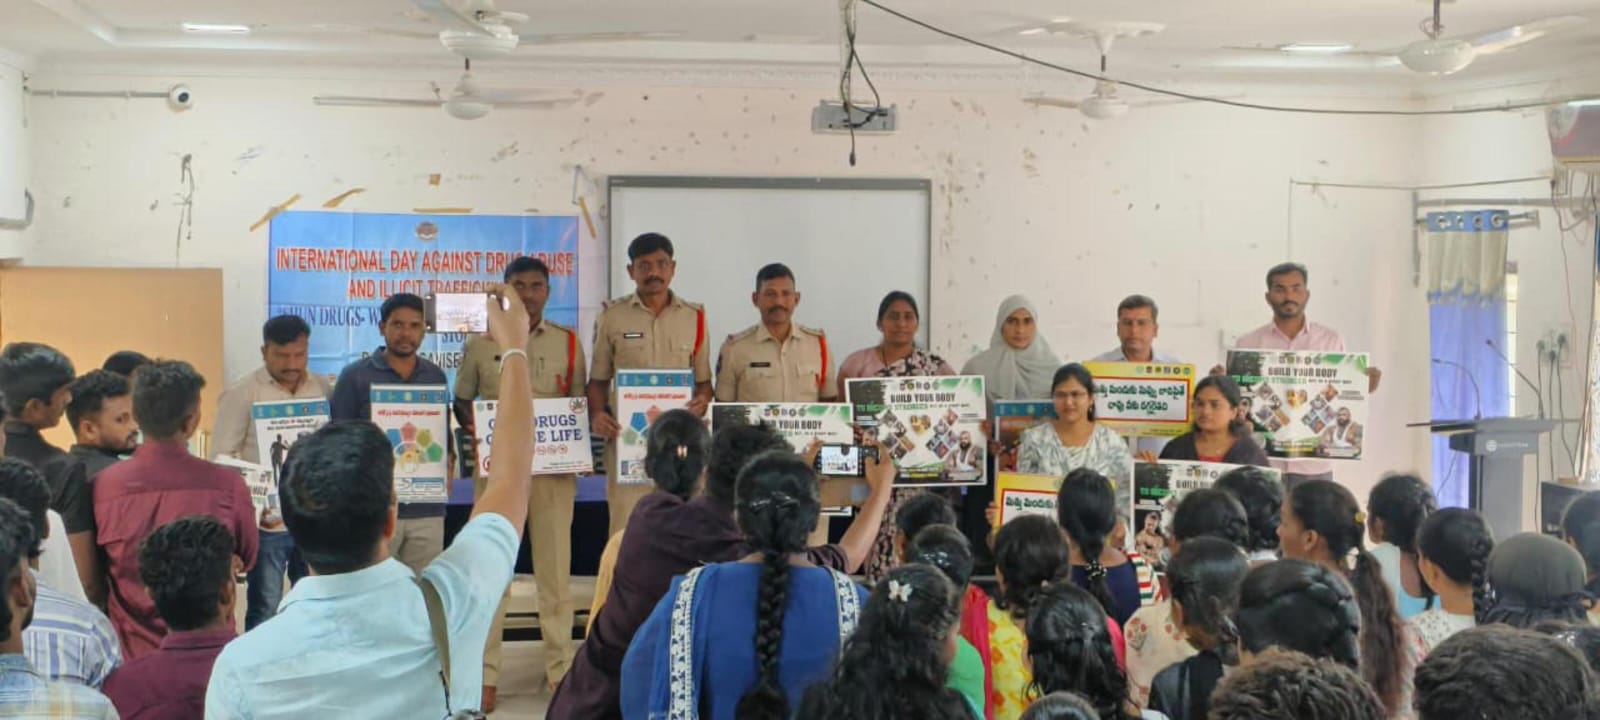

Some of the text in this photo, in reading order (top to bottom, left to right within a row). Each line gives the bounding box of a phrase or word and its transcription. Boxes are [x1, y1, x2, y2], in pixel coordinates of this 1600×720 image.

[276, 247, 387, 272] INTERNATIONAL
[390, 250, 417, 273] DAY
[421, 251, 481, 274] AGAINST
[347, 279, 376, 299] AND
[801, 420, 822, 430] BODY
[551, 428, 583, 442] LIFE
